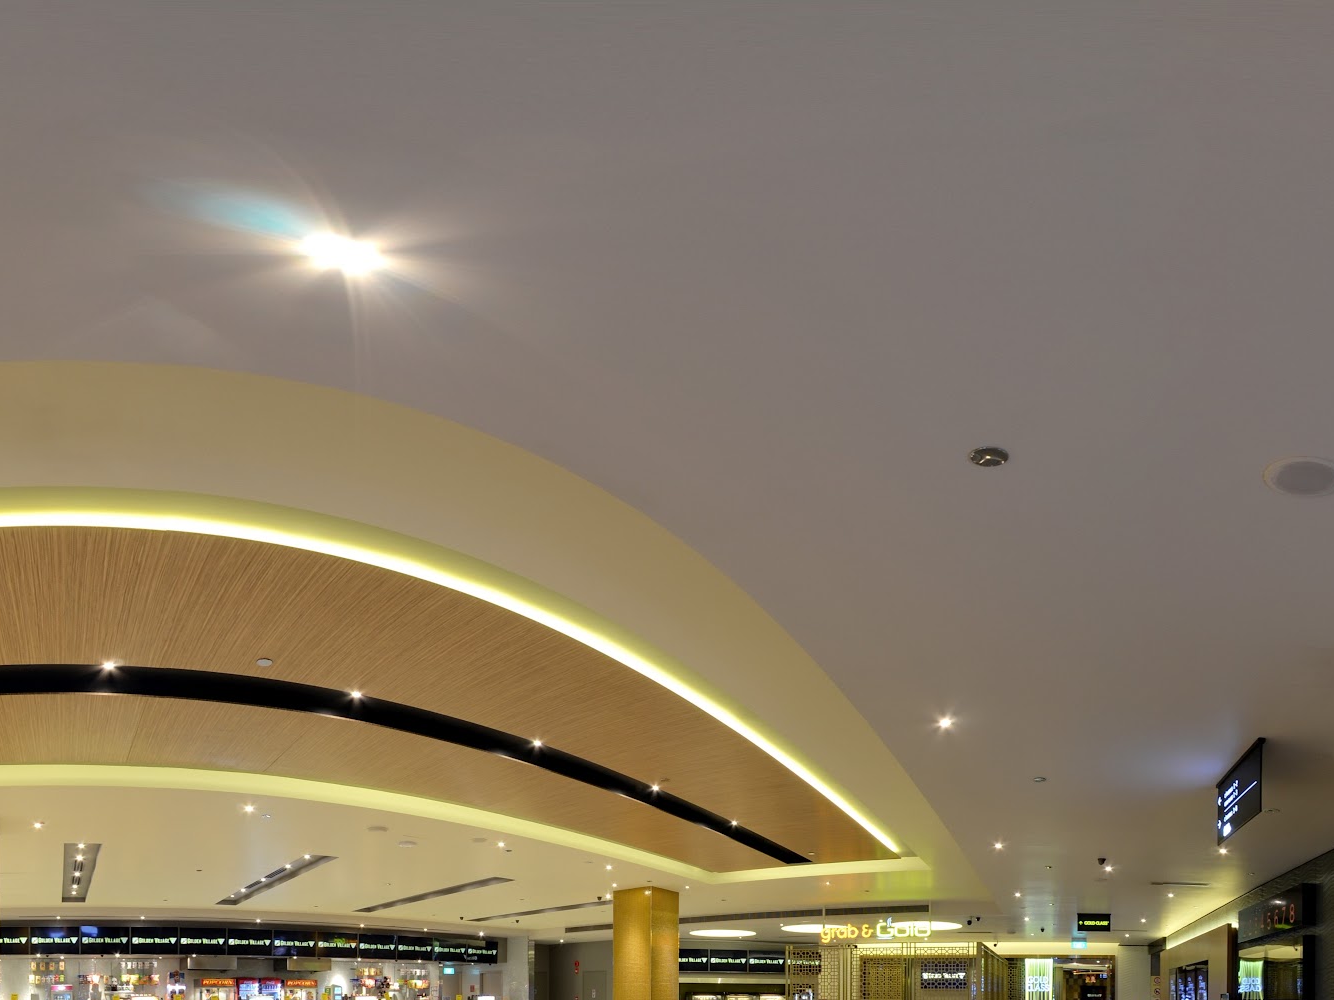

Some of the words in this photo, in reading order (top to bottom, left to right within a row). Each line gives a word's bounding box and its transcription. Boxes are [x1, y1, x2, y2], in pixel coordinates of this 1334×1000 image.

[1281, 906, 1286, 924] 7
[1289, 904, 1295, 923] 8
[821, 924, 859, 943] grab
[861, 924, 873, 938] &
[877, 920, 931, 938] Gold
[1027, 983, 1049, 992] CLASS
